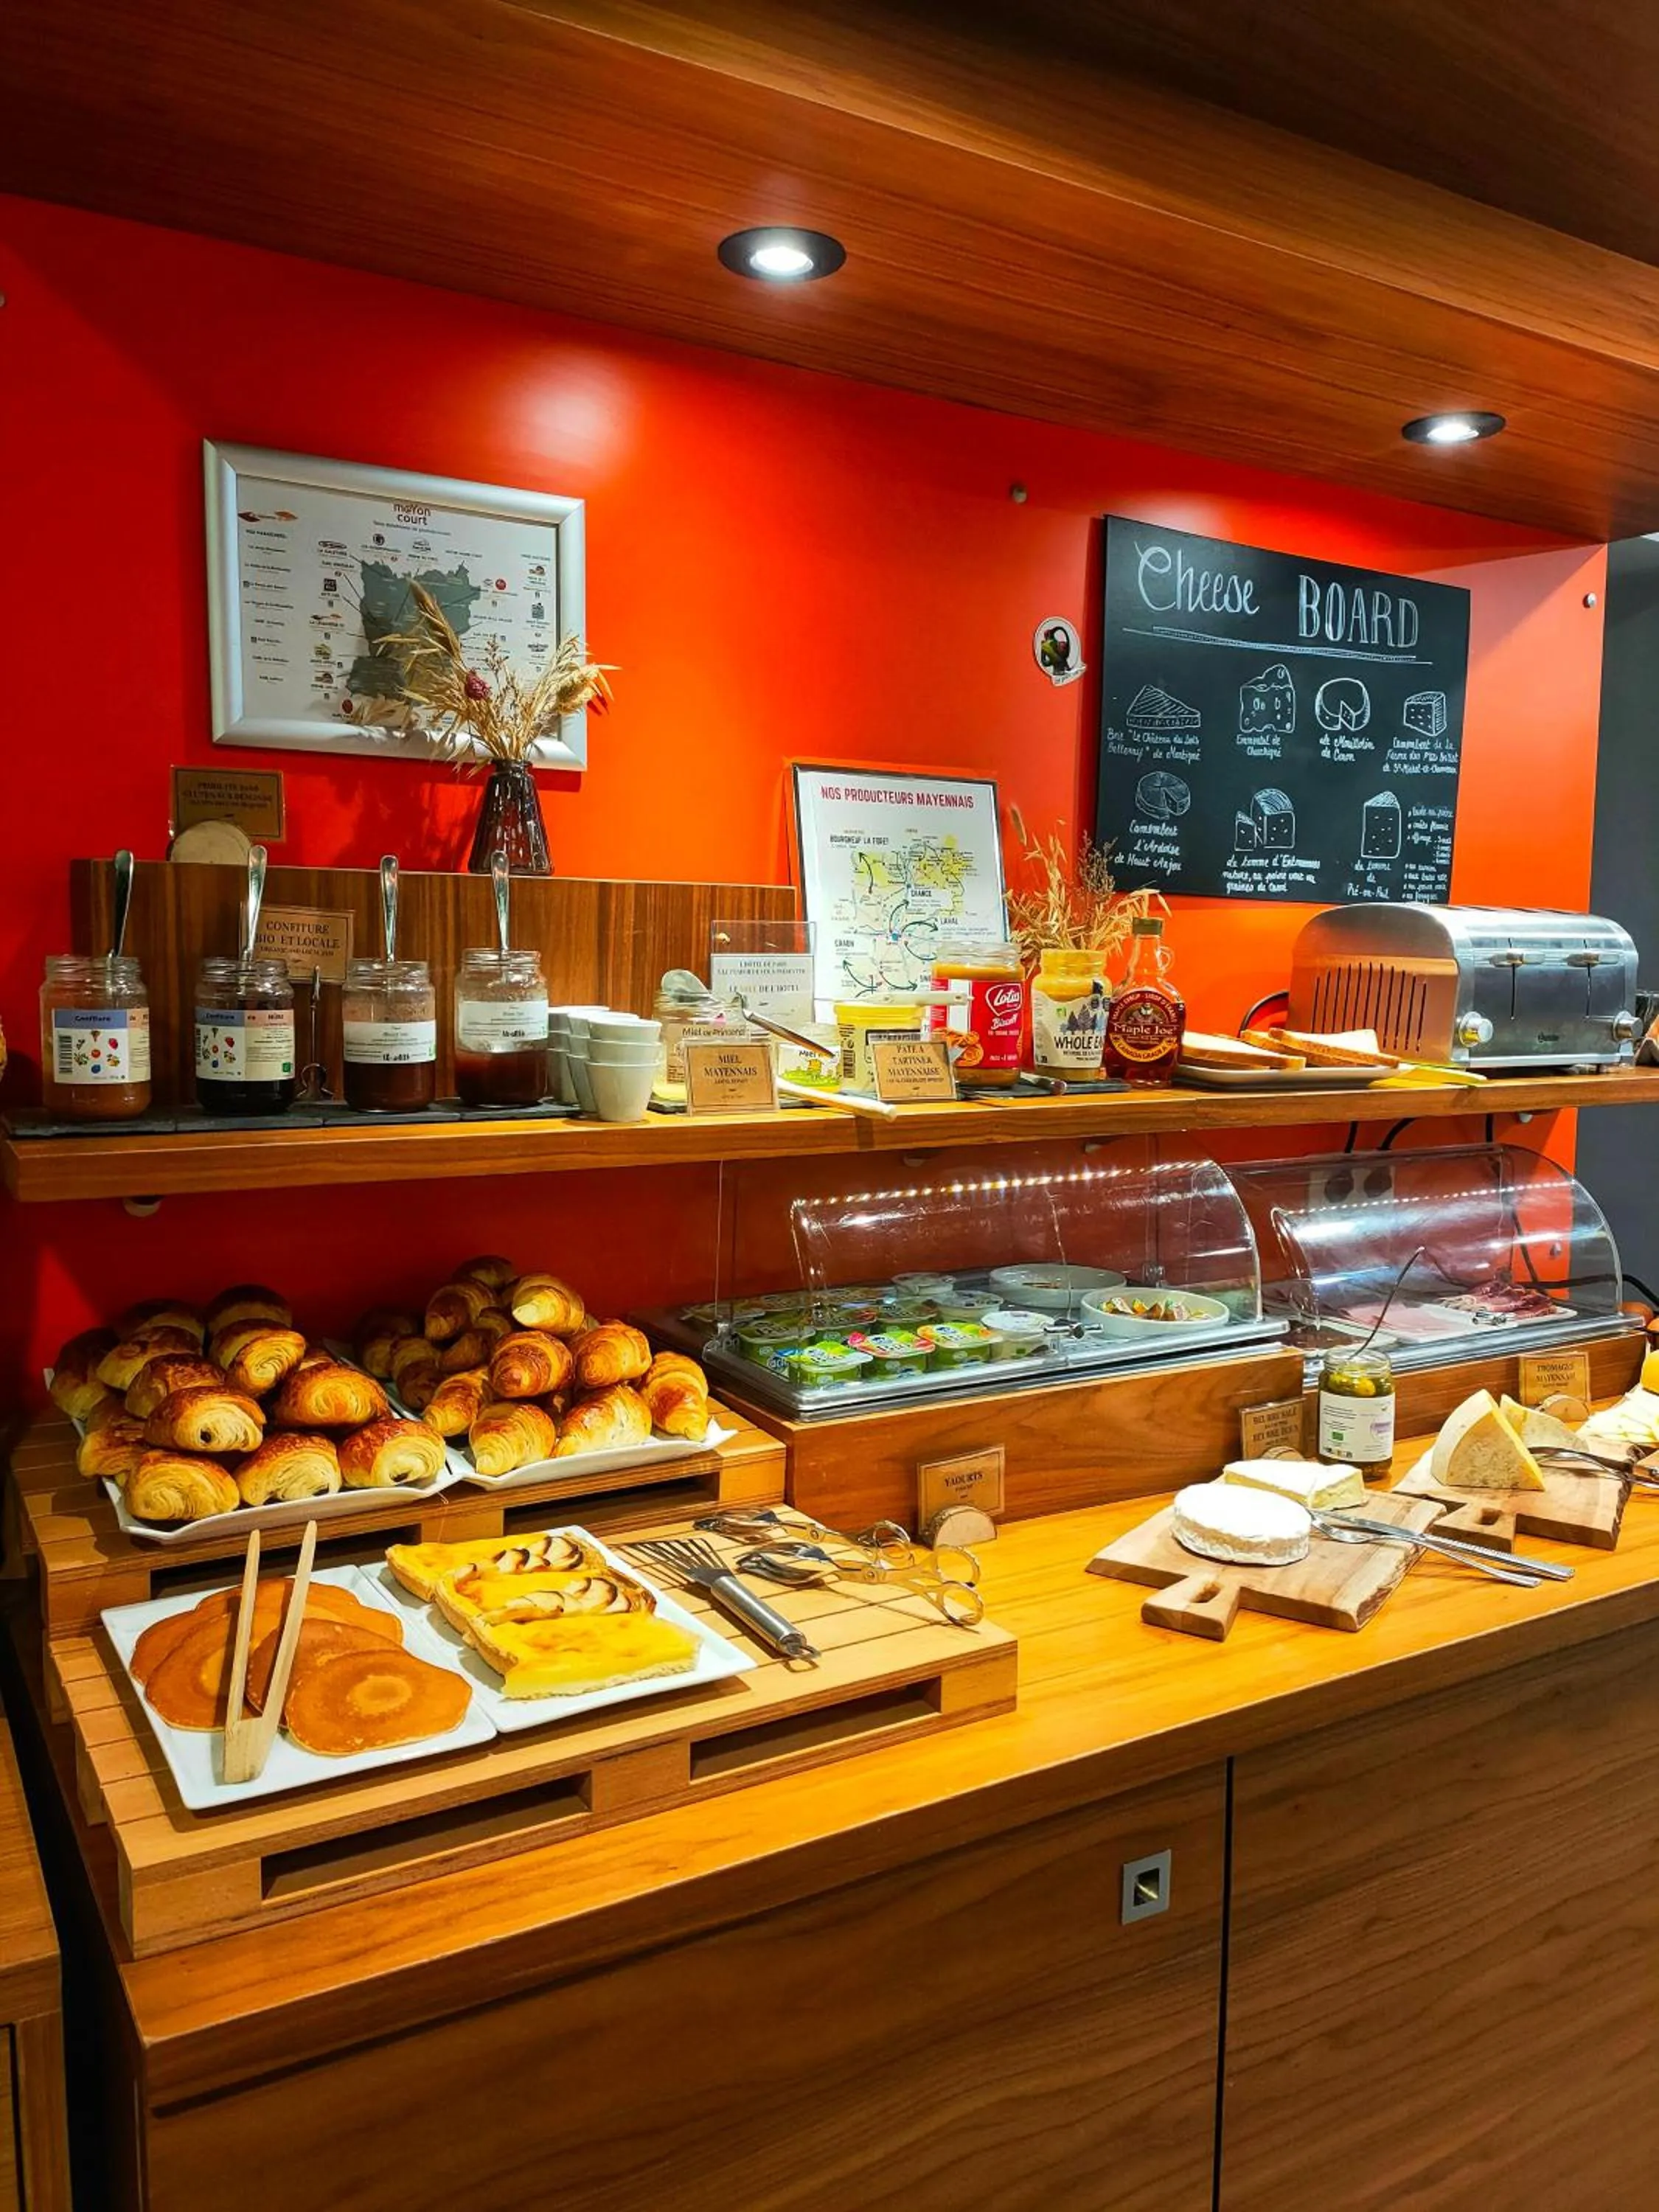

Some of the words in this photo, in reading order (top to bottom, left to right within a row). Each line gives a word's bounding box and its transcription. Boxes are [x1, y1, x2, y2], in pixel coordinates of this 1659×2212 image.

[1135, 541, 1259, 614] Cheese
[1298, 574, 1418, 648] BOARD
[821, 786, 841, 799] NOS
[844, 789, 914, 804] PRODUCTEURS
[917, 793, 974, 808] MAYENNAIS
[1129, 819, 1178, 836] Camembert
[266, 921, 330, 934] CONFITURE
[281, 935, 294, 945] ET
[297, 936, 341, 949] LOCALE
[1113, 1023, 1151, 1036] Maple
[1155, 1025, 1174, 1035] Joe
[1054, 1036, 1092, 1049] WHOLE
[718, 1054, 742, 1064] MIEL
[703, 1067, 758, 1077] MAYENNAIS
[888, 1067, 940, 1076] MAYENNAISE
